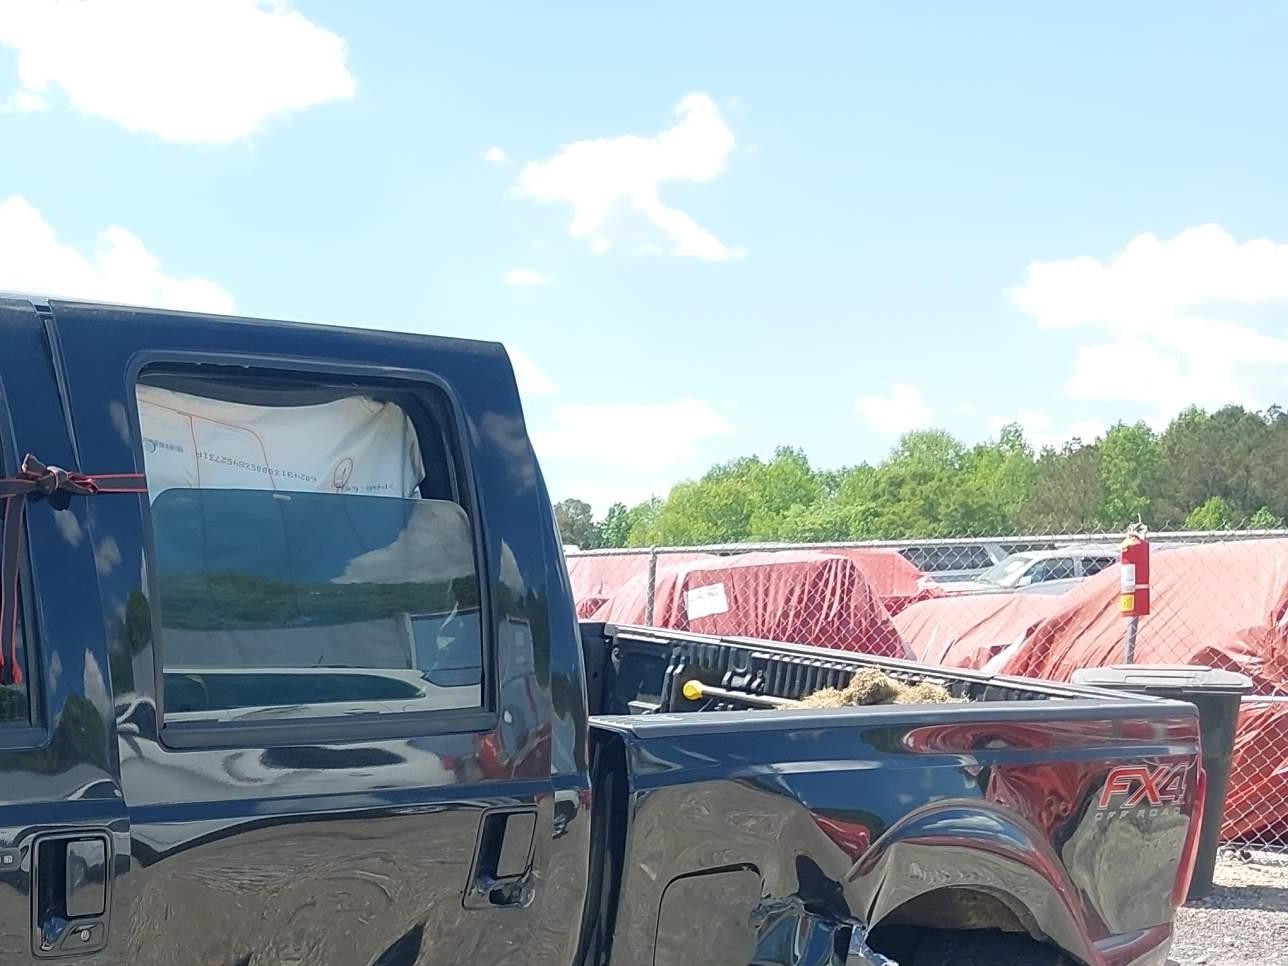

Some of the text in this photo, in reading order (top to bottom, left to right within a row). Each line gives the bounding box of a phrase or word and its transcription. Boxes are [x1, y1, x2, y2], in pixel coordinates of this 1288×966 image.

[1097, 764, 1186, 810] FX4
[1095, 807, 1181, 821] OFF ROAD
